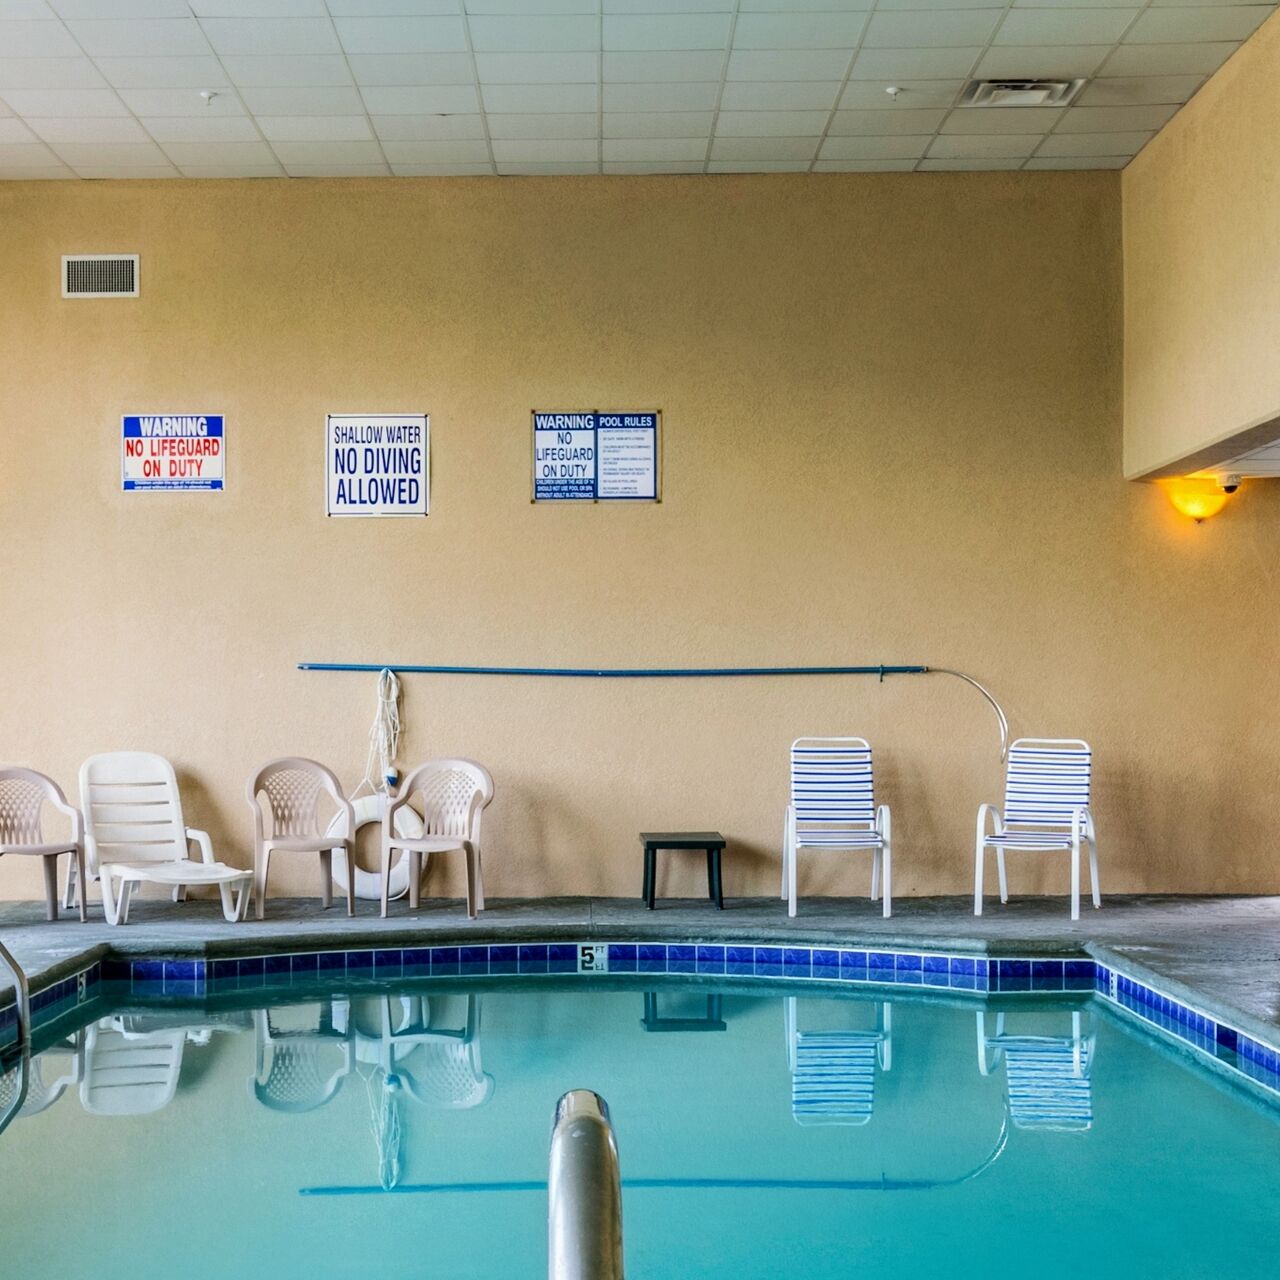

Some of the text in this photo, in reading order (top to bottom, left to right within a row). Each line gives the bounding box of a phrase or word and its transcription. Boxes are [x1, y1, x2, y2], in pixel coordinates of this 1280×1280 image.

[139, 417, 208, 436] WARNING
[535, 415, 594, 429] WARNING
[600, 416, 652, 427] POOL RULES
[334, 426, 420, 444] SHALLOW WATER
[557, 432, 572, 444] NO
[126, 439, 219, 457] NO LIFEGUARD
[536, 448, 593, 460] LIFEGUARD
[143, 459, 203, 477] ON DUTY
[335, 448, 421, 474] NO DIVING
[542, 464, 587, 477] ON DUTY
[336, 478, 419, 504] ALLOWED
